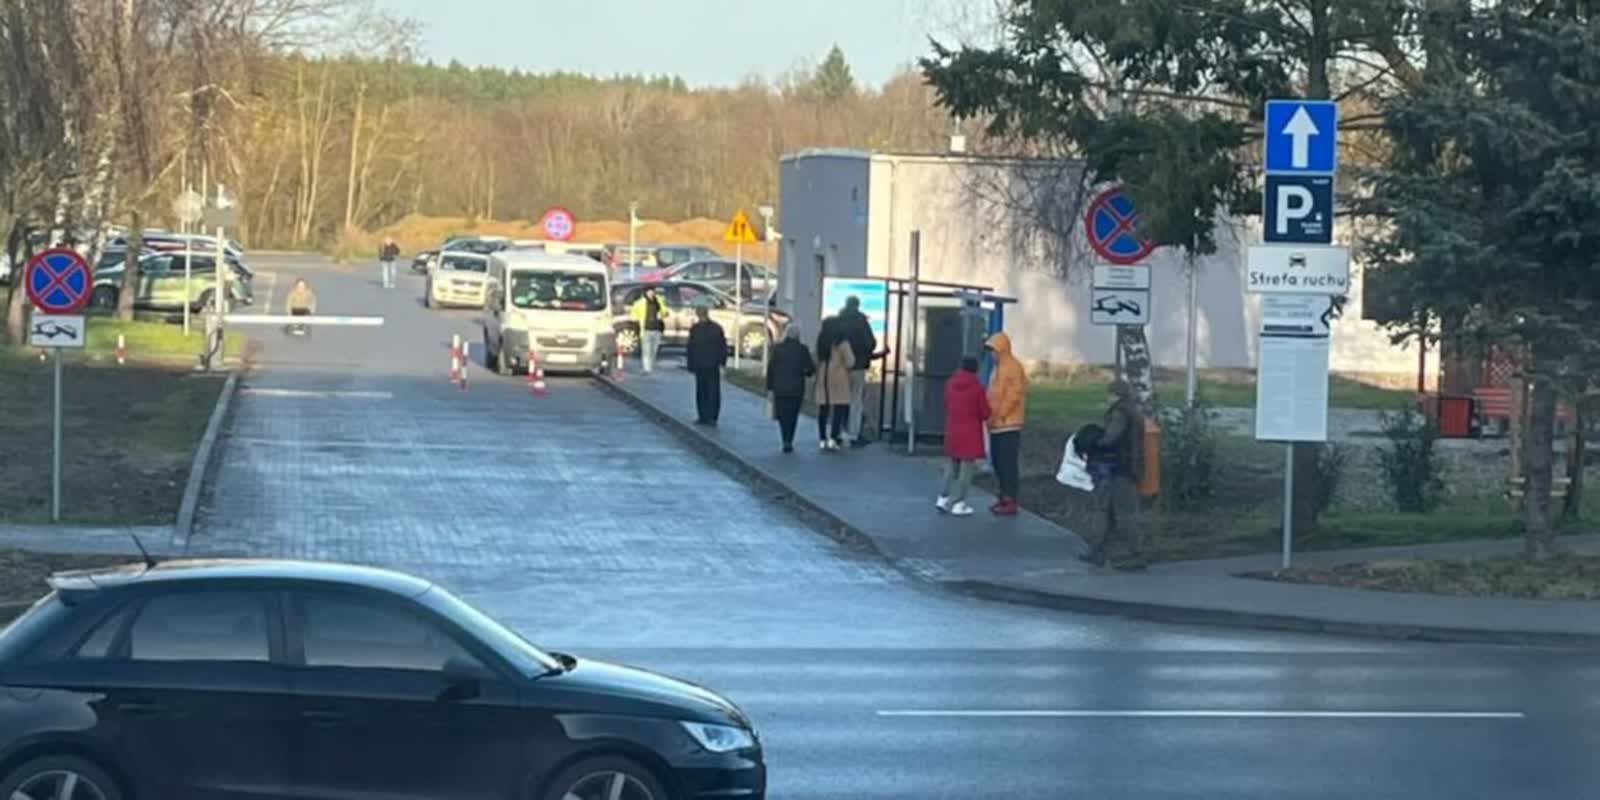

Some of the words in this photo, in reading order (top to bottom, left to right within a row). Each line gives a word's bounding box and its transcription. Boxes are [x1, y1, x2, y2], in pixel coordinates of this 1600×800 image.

[1277, 185, 1313, 234] P
[1250, 271, 1297, 286] Strefa
[1303, 272, 1345, 287] ruchu
